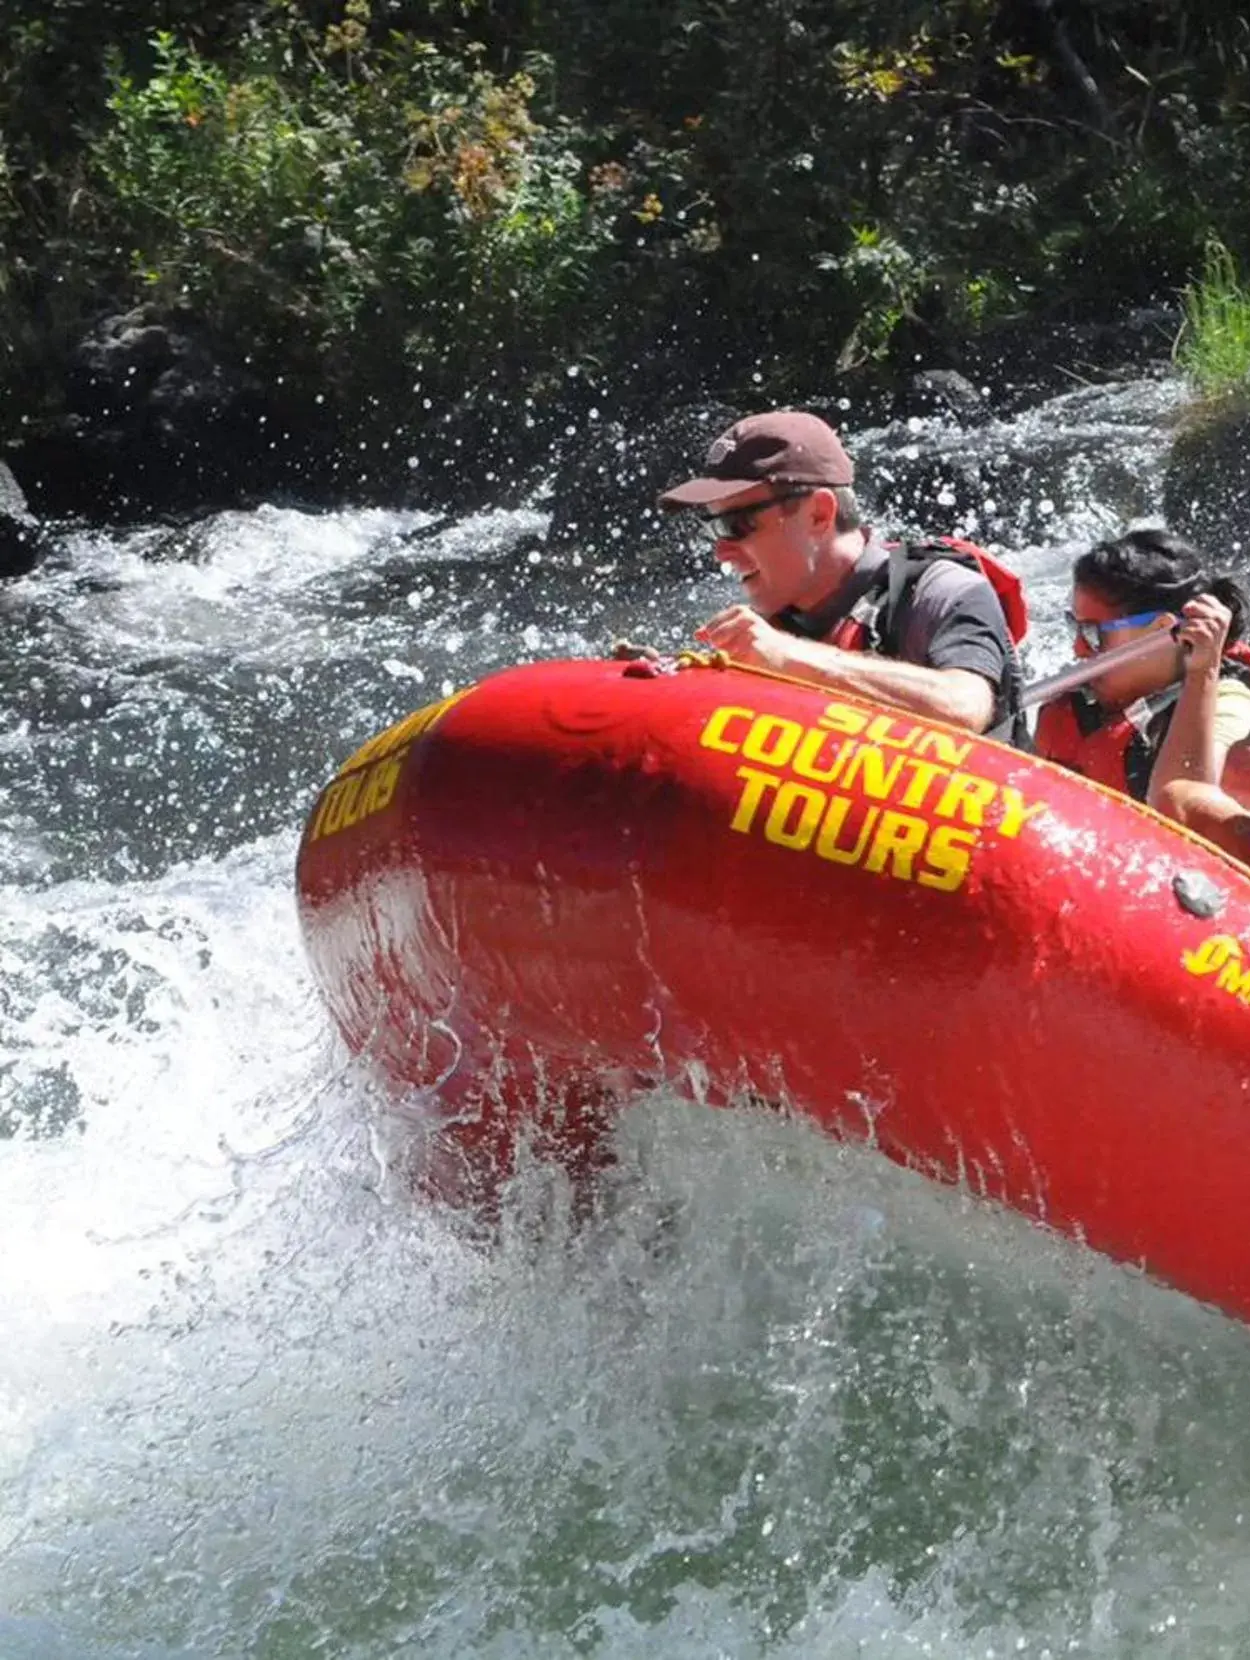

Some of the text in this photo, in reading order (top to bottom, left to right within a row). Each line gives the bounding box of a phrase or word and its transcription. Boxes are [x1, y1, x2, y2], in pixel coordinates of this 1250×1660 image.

[700, 706, 1047, 839] COUNTRY
[818, 702, 973, 766] SUN
[730, 767, 976, 892] TOURS
